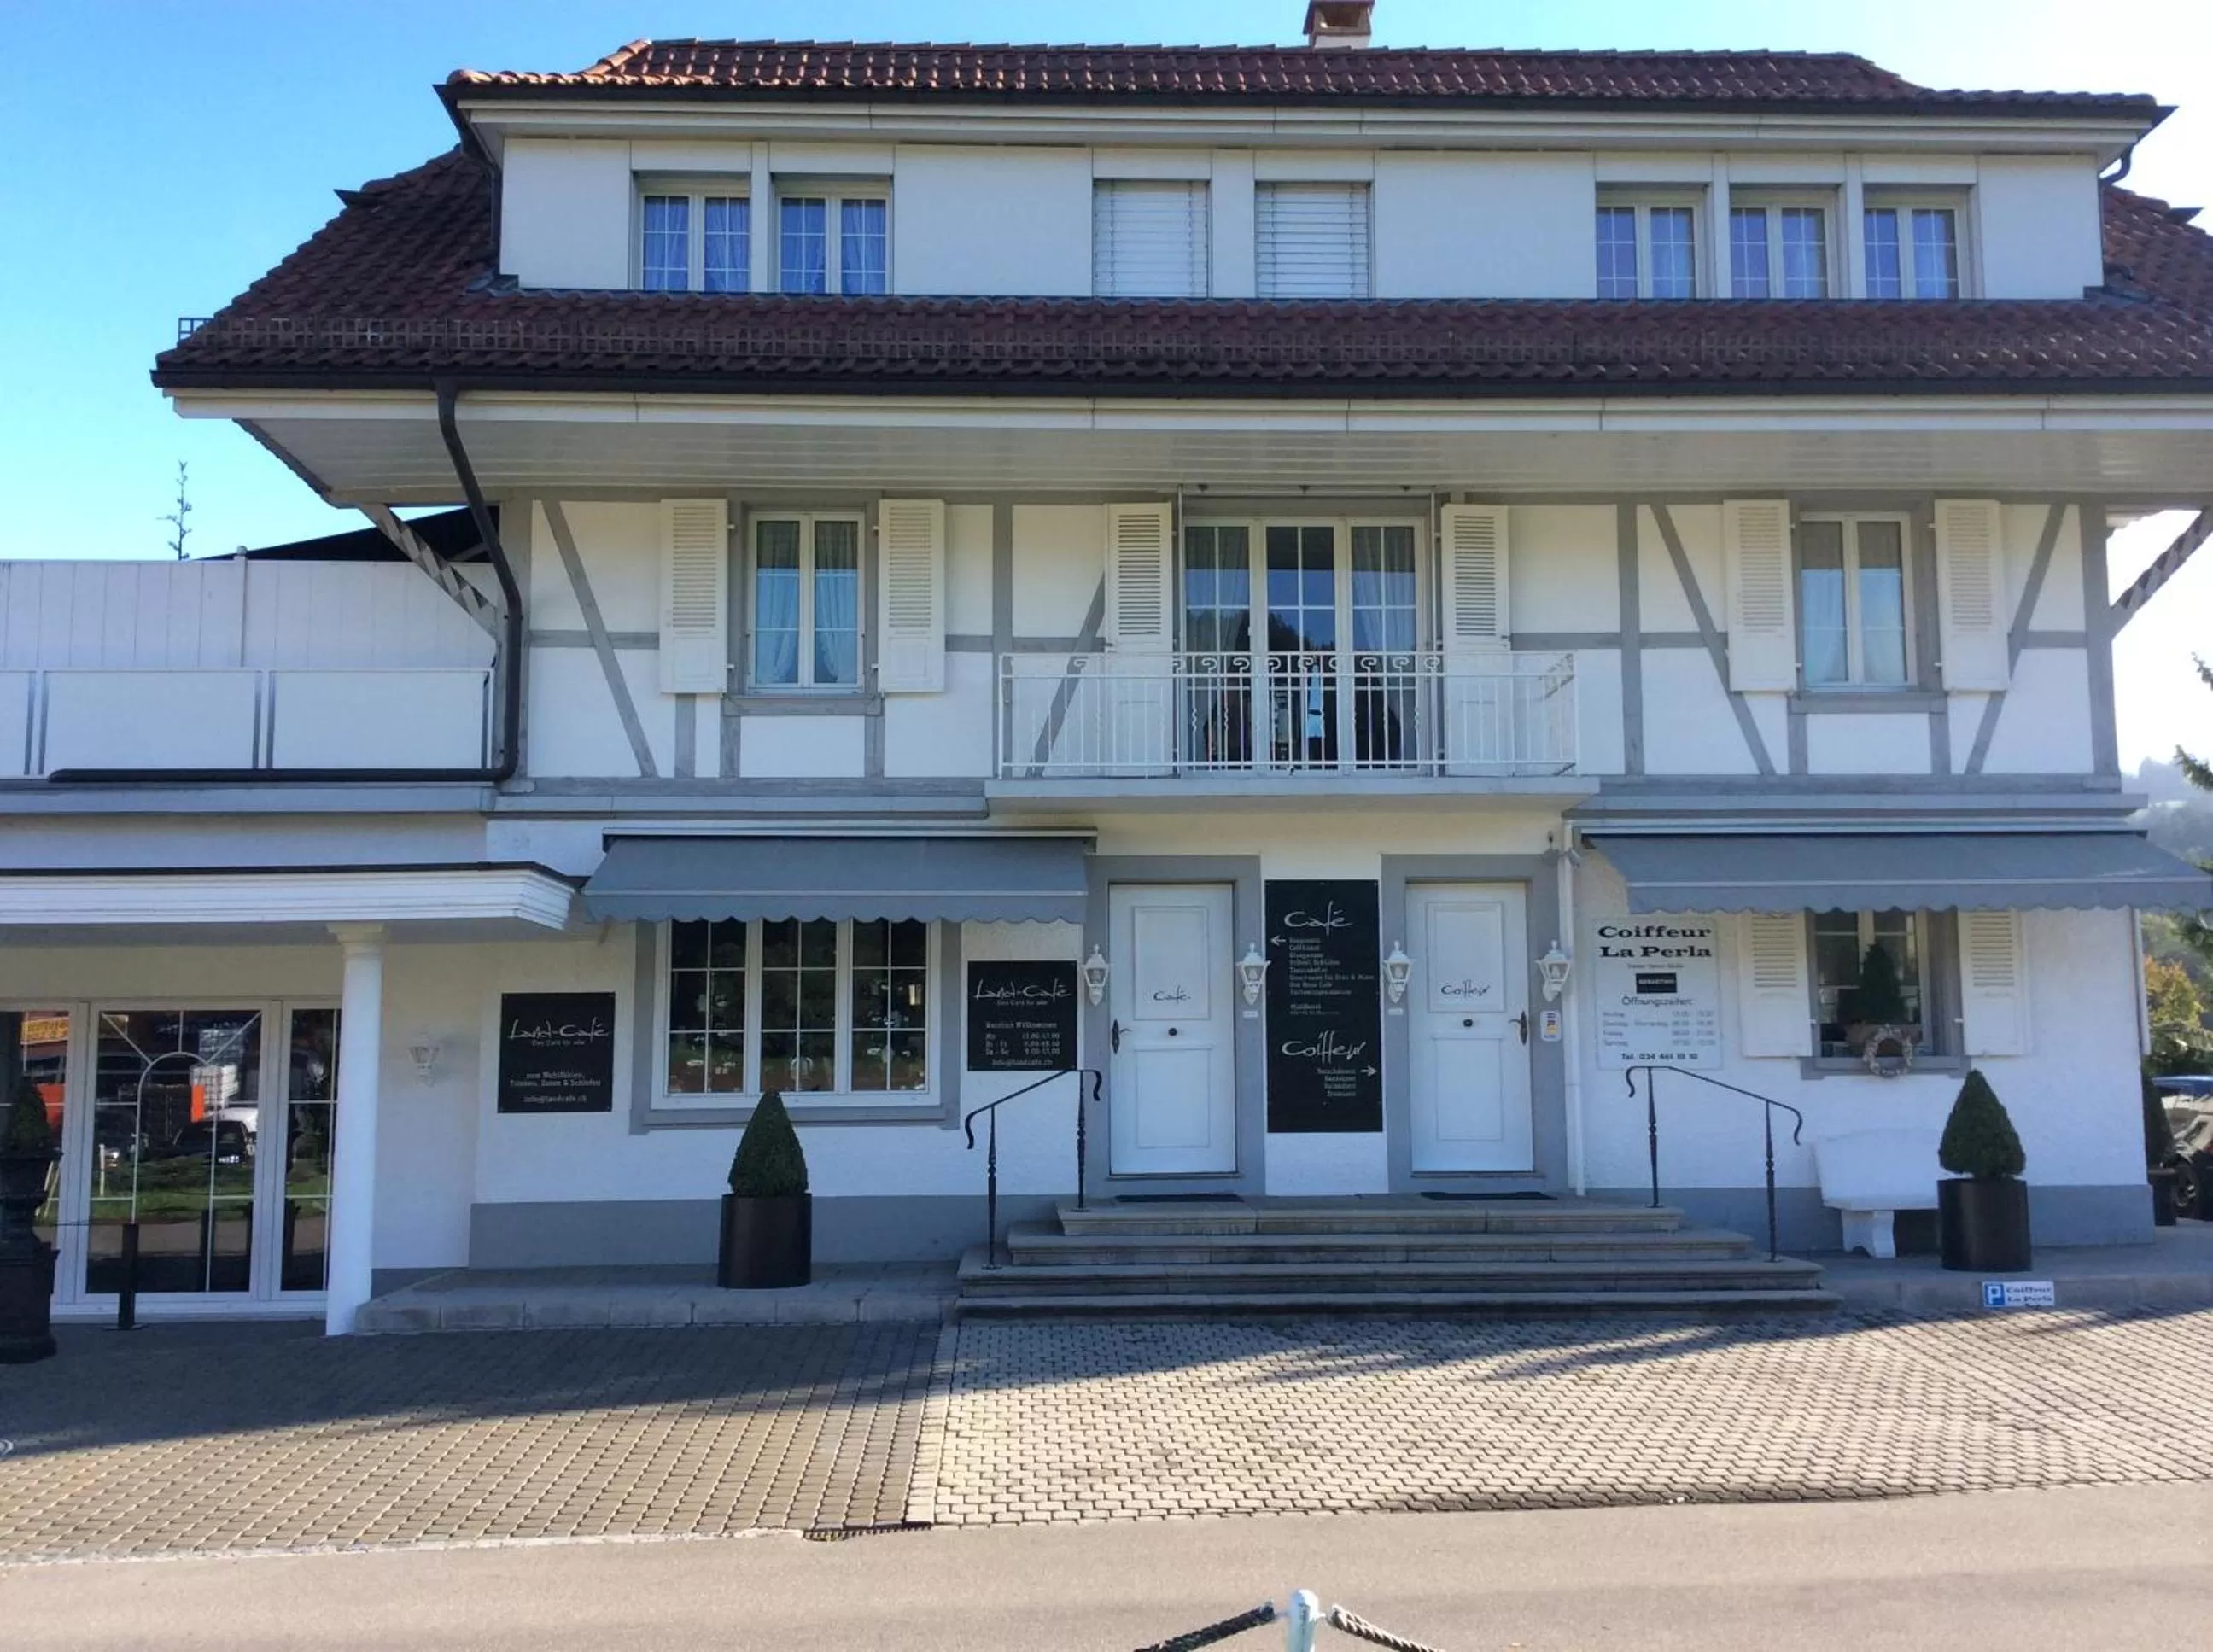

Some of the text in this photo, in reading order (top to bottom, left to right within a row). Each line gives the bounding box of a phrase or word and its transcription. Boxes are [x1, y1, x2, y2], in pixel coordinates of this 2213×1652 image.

[1283, 900, 1353, 936] Café
[1597, 925, 1712, 938] Coiffeur
[1599, 945, 1712, 958] La Perla
[1153, 984, 1192, 1004] Café
[1440, 978, 1491, 998] Coiffeur
[1282, 1030, 1366, 1064] Coiffeur
[1988, 1286, 2001, 1305] P
